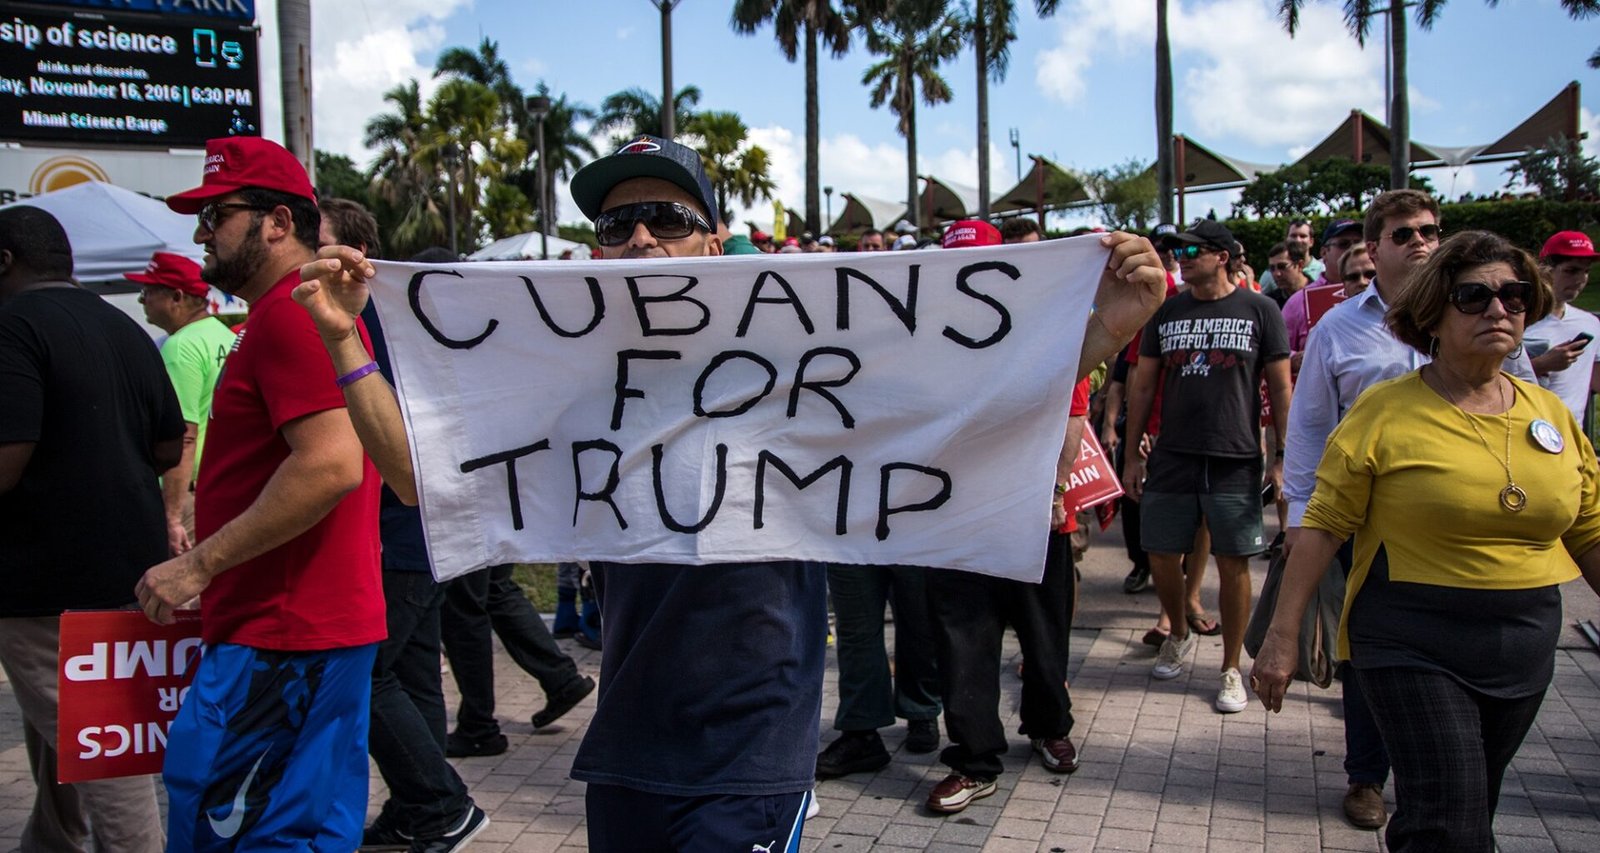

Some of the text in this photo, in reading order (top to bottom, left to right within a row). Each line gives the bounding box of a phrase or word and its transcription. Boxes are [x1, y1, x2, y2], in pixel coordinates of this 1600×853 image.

[46, 21, 74, 47] of
[77, 25, 178, 55] science
[30, 76, 118, 99] November
[224, 88, 252, 107] PM
[22, 110, 168, 135] Miami Science Barge
[957, 233, 976, 241] AGAIN
[408, 261, 1021, 349] CUBANS
[1159, 318, 1253, 336] MAKE AMERICA
[1211, 333, 1253, 352] AGAIN.
[610, 346, 860, 430] FOR
[461, 438, 952, 541] TRUMP
[64, 637, 208, 682] UMP
[77, 720, 172, 760] NICS
